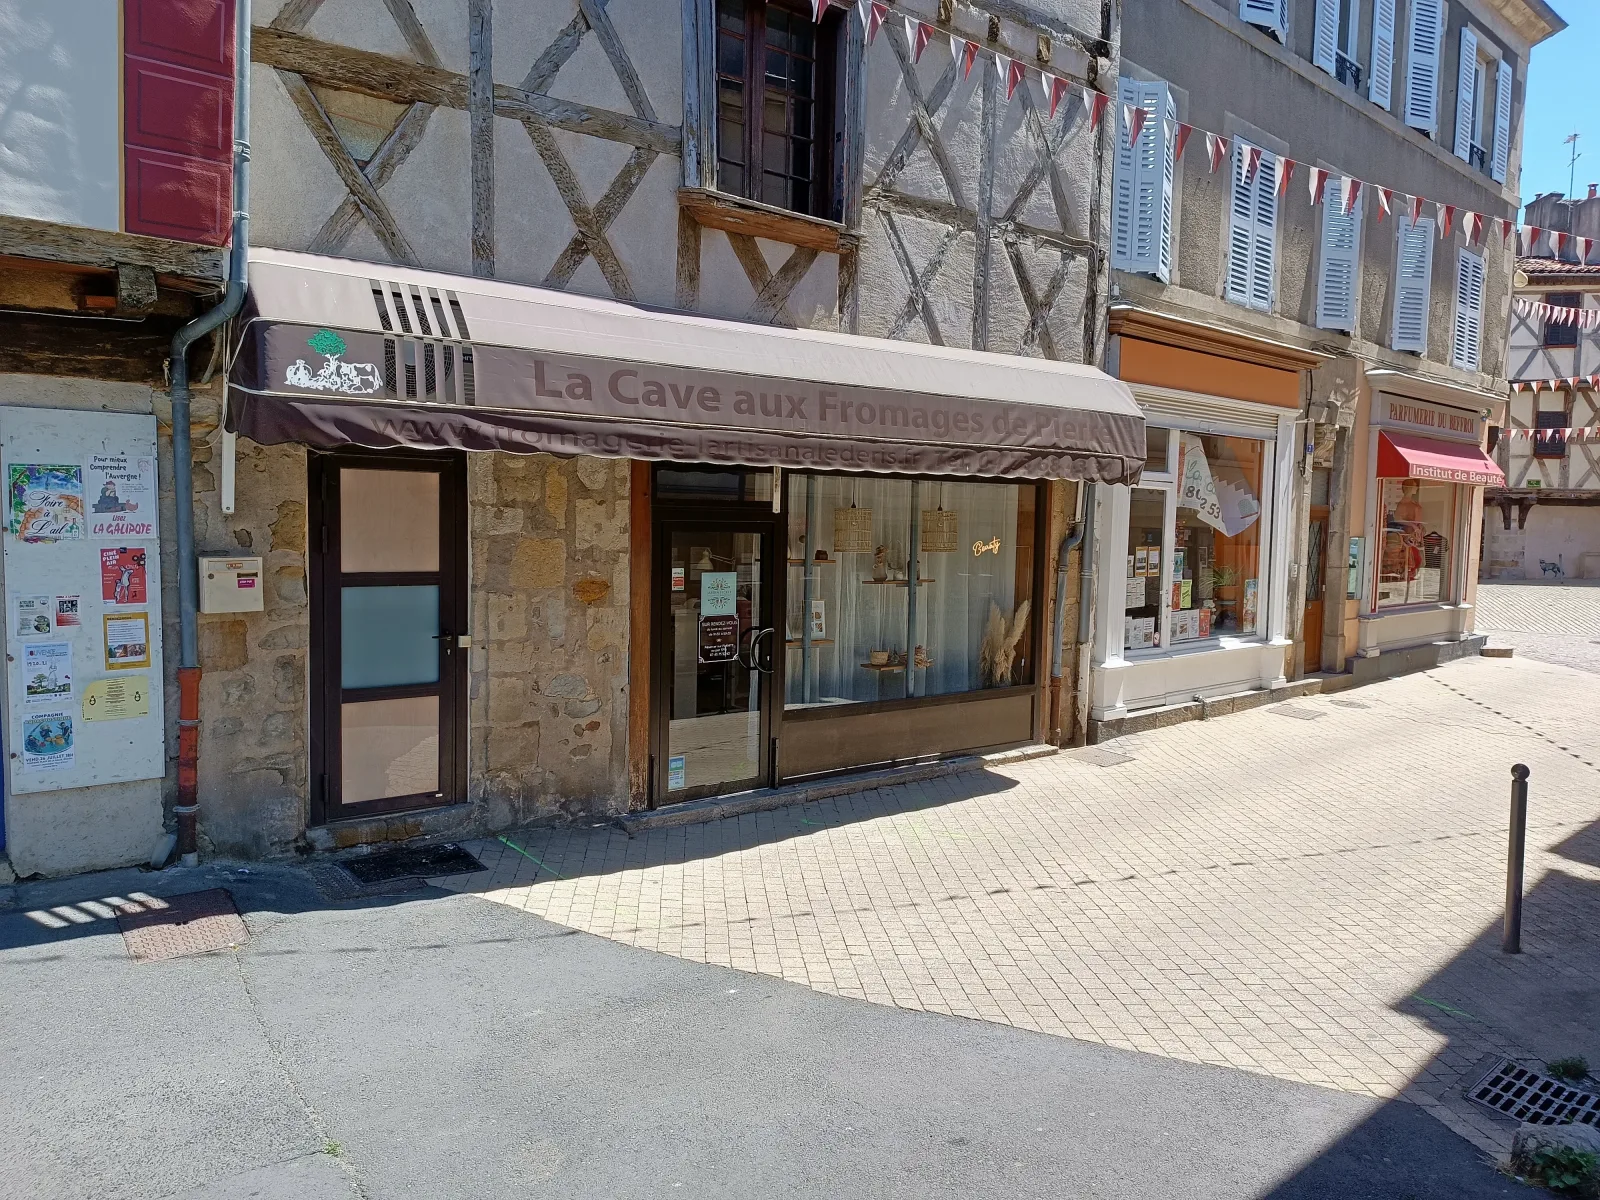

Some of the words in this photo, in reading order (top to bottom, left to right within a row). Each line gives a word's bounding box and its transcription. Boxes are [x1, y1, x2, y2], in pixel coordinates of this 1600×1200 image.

[533, 360, 593, 401] La
[607, 369, 724, 412] Cave
[733, 390, 808, 420] aux
[818, 390, 985, 438] Fromages
[992, 408, 1027, 437] de
[1036, 411, 1114, 444] Pierre
[1389, 403, 1435, 427] PARFUMERIE
[1437, 412, 1447, 428] DU
[90, 464, 127, 472] Comprendre
[109, 456, 127, 464] mieux
[1413, 464, 1453, 480] Institut
[1454, 469, 1468, 481] de
[29, 491, 63, 508] Foire
[43, 509, 51, 518] à
[93, 523, 104, 534] LA
[106, 523, 152, 535] GALIPOTE
[972, 536, 1001, 556] Beauty
